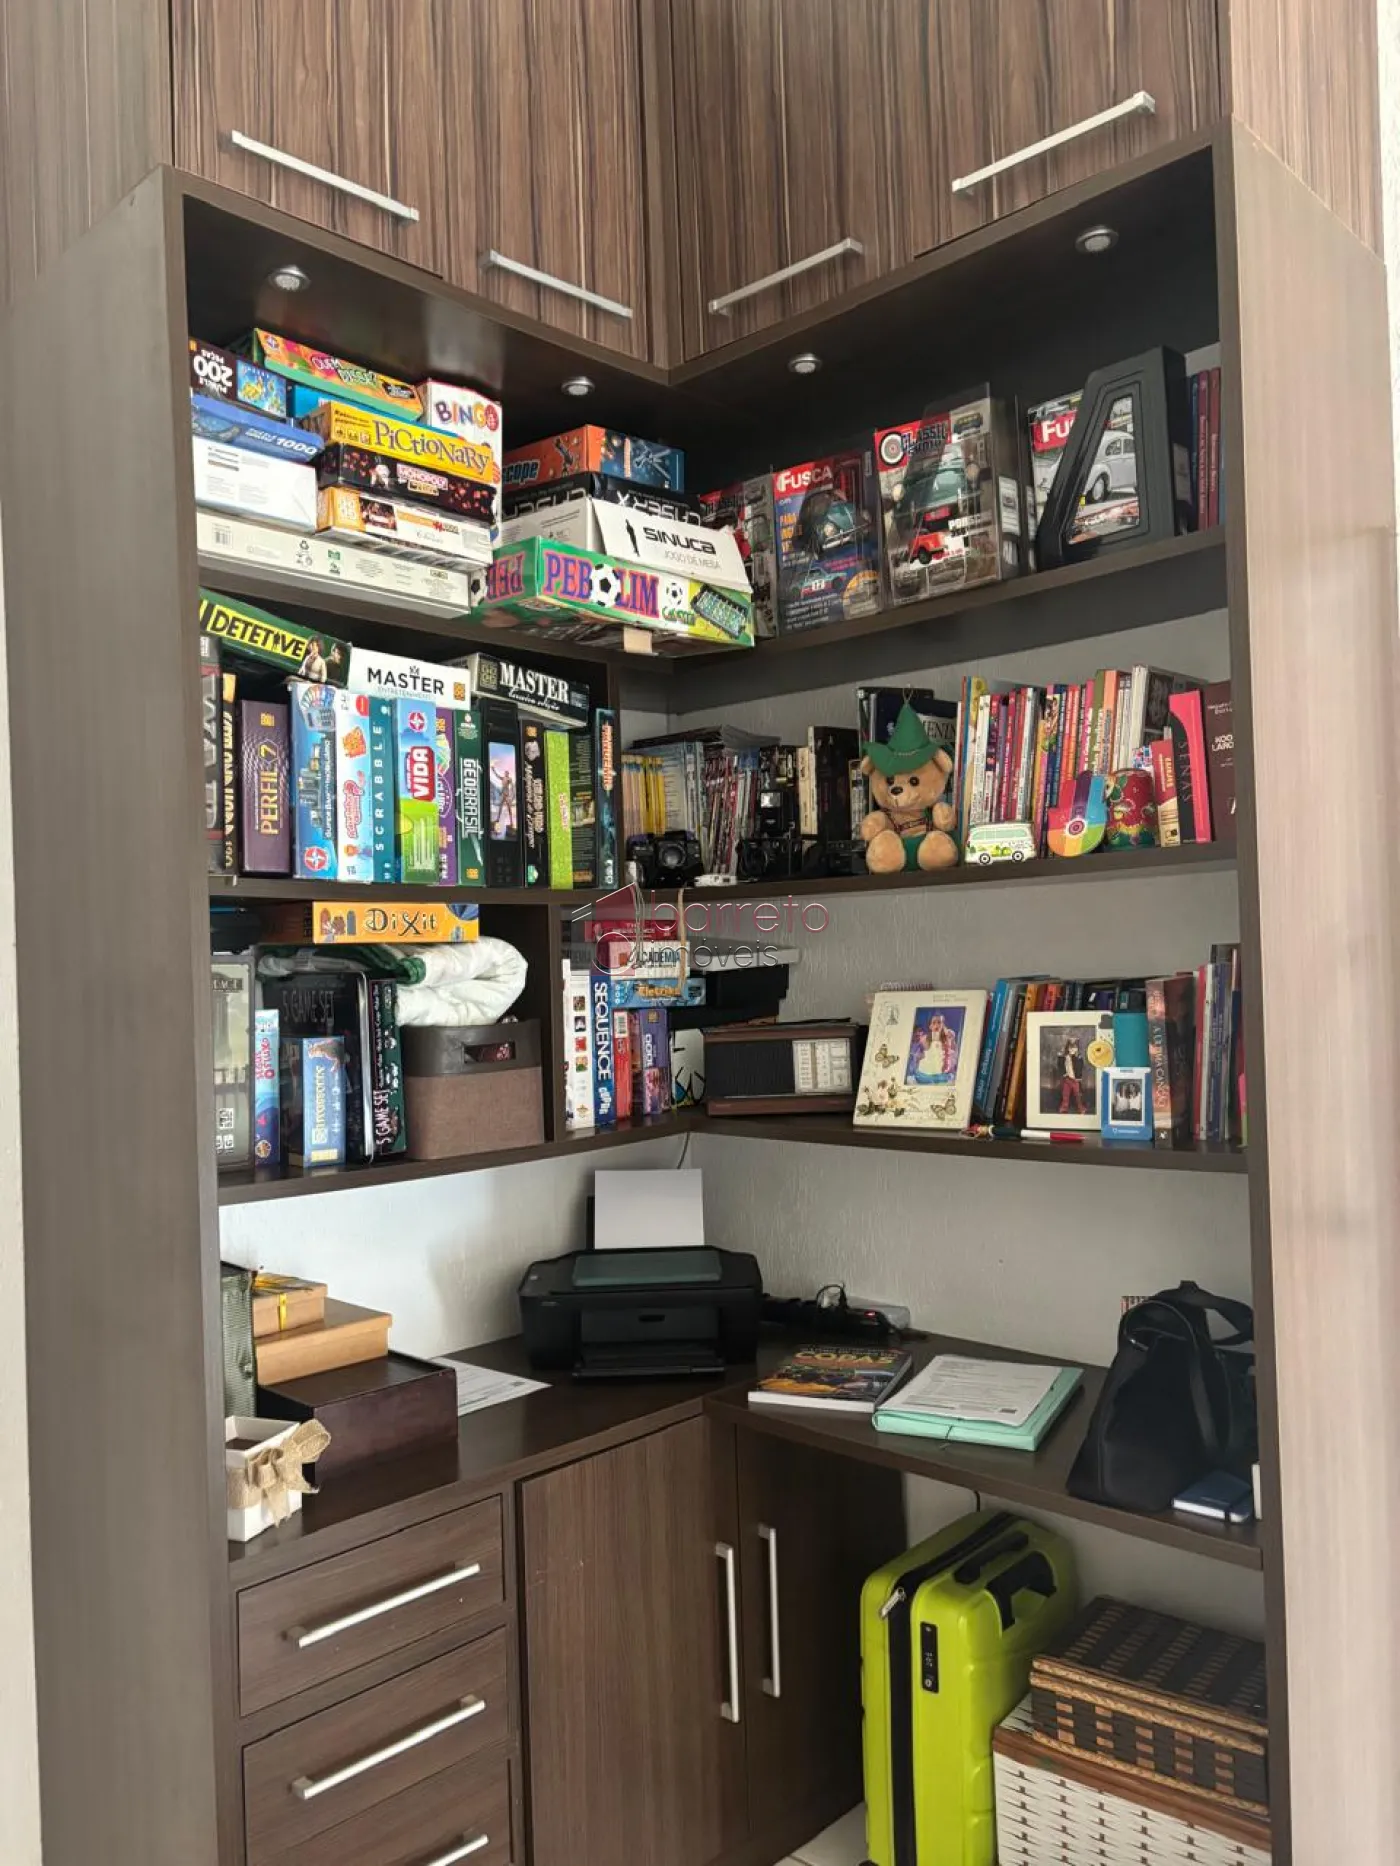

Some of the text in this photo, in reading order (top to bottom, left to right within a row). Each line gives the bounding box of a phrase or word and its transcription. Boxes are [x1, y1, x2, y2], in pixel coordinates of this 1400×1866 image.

[193, 355, 233, 387] 200
[435, 400, 500, 431] BINGO
[276, 437, 317, 455] 1000
[776, 465, 833, 492] FUSCA
[210, 611, 305, 658] DETETIVE
[367, 667, 444, 696] MASTER
[500, 661, 569, 704] MASTER
[373, 725, 384, 851] SCRABBLE
[414, 748, 430, 797] VIDA
[259, 744, 280, 836] PERFIL 7
[464, 758, 478, 837] GEOBRASIL
[291, 989, 317, 1022] GAME
[595, 982, 611, 1081] SEQUENCE
[373, 1088, 391, 1106] SET
[375, 1107, 391, 1136] GAME
